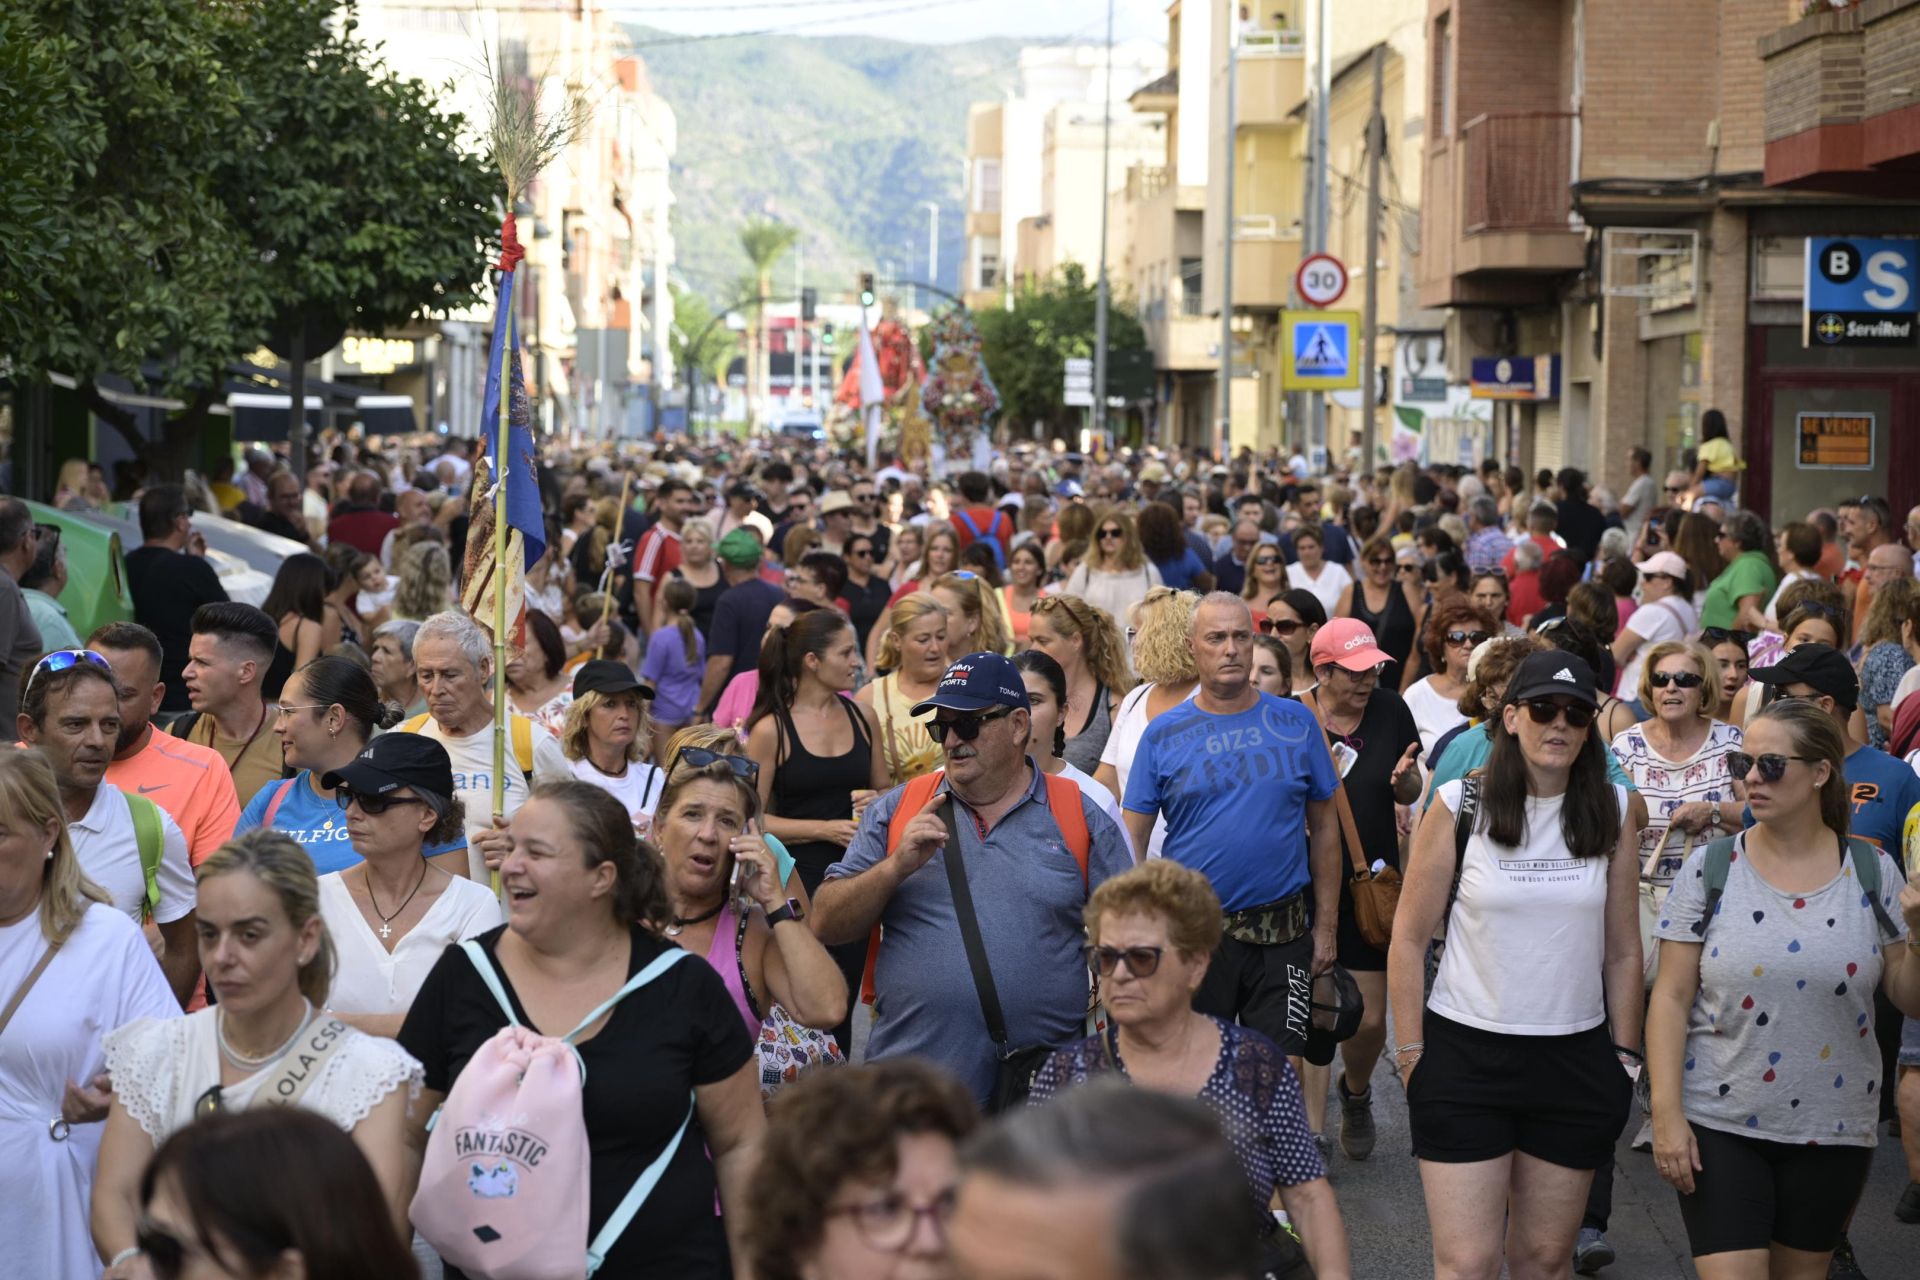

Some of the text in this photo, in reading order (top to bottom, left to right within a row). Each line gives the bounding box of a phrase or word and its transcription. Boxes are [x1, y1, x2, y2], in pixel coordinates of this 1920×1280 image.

[1307, 270, 1337, 290] 30
[1829, 250, 1910, 310] B S
[1846, 320, 1911, 338] ServiRed
[940, 678, 967, 688] SPORTS
[999, 686, 1020, 699] TOMMY
[272, 826, 350, 843] LFIG
[1551, 859, 1582, 868] BELIEVES
[1548, 874, 1580, 882] ACHIEVES
[1286, 964, 1311, 1041] NIKE
[455, 1131, 547, 1167] FANTASTIC
